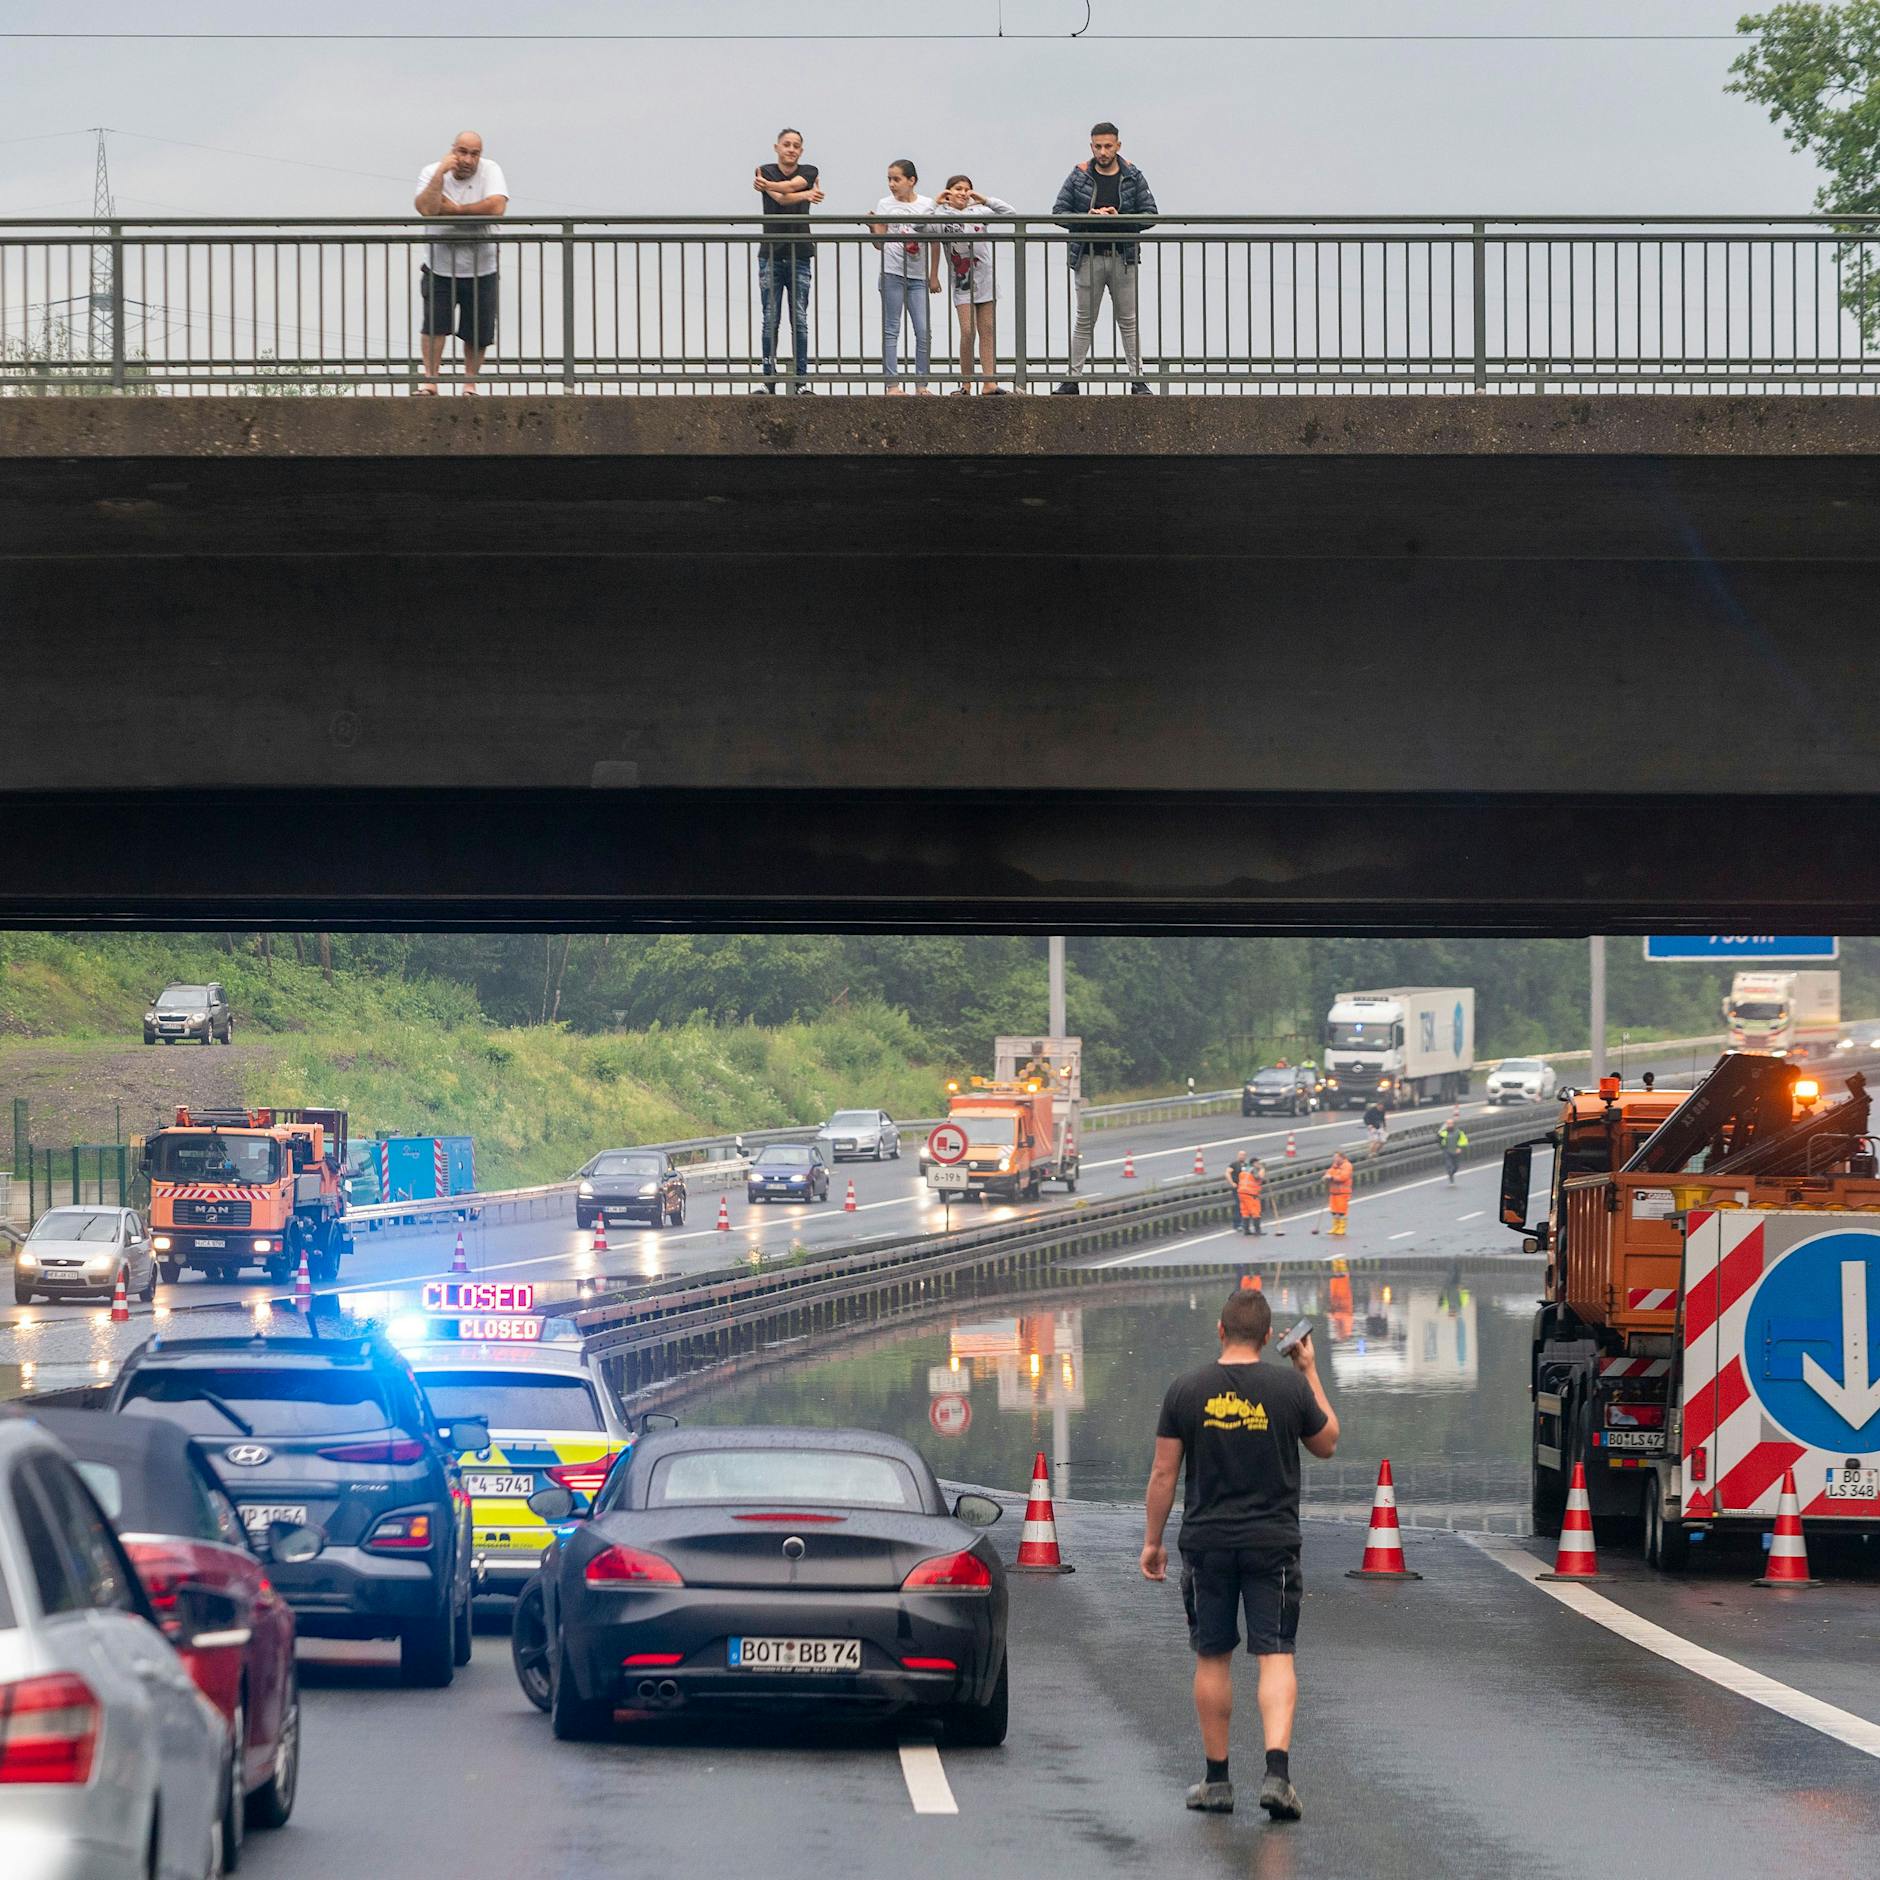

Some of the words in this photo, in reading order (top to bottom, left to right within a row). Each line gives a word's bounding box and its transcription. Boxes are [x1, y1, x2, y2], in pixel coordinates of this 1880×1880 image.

[195, 1205, 229, 1213] MAN
[422, 1282, 534, 1311] CLOSED
[460, 1319, 539, 1340] CLOSED
[1609, 1433, 1623, 1445] BO
[1631, 1434, 1645, 1446] LS
[1843, 1470, 1861, 1483] BO
[1830, 1484, 1847, 1497] LS
[1850, 1484, 1874, 1497] 348
[742, 1641, 784, 1662] BOT
[800, 1643, 827, 1663] BB
[832, 1643, 858, 1664] 74
